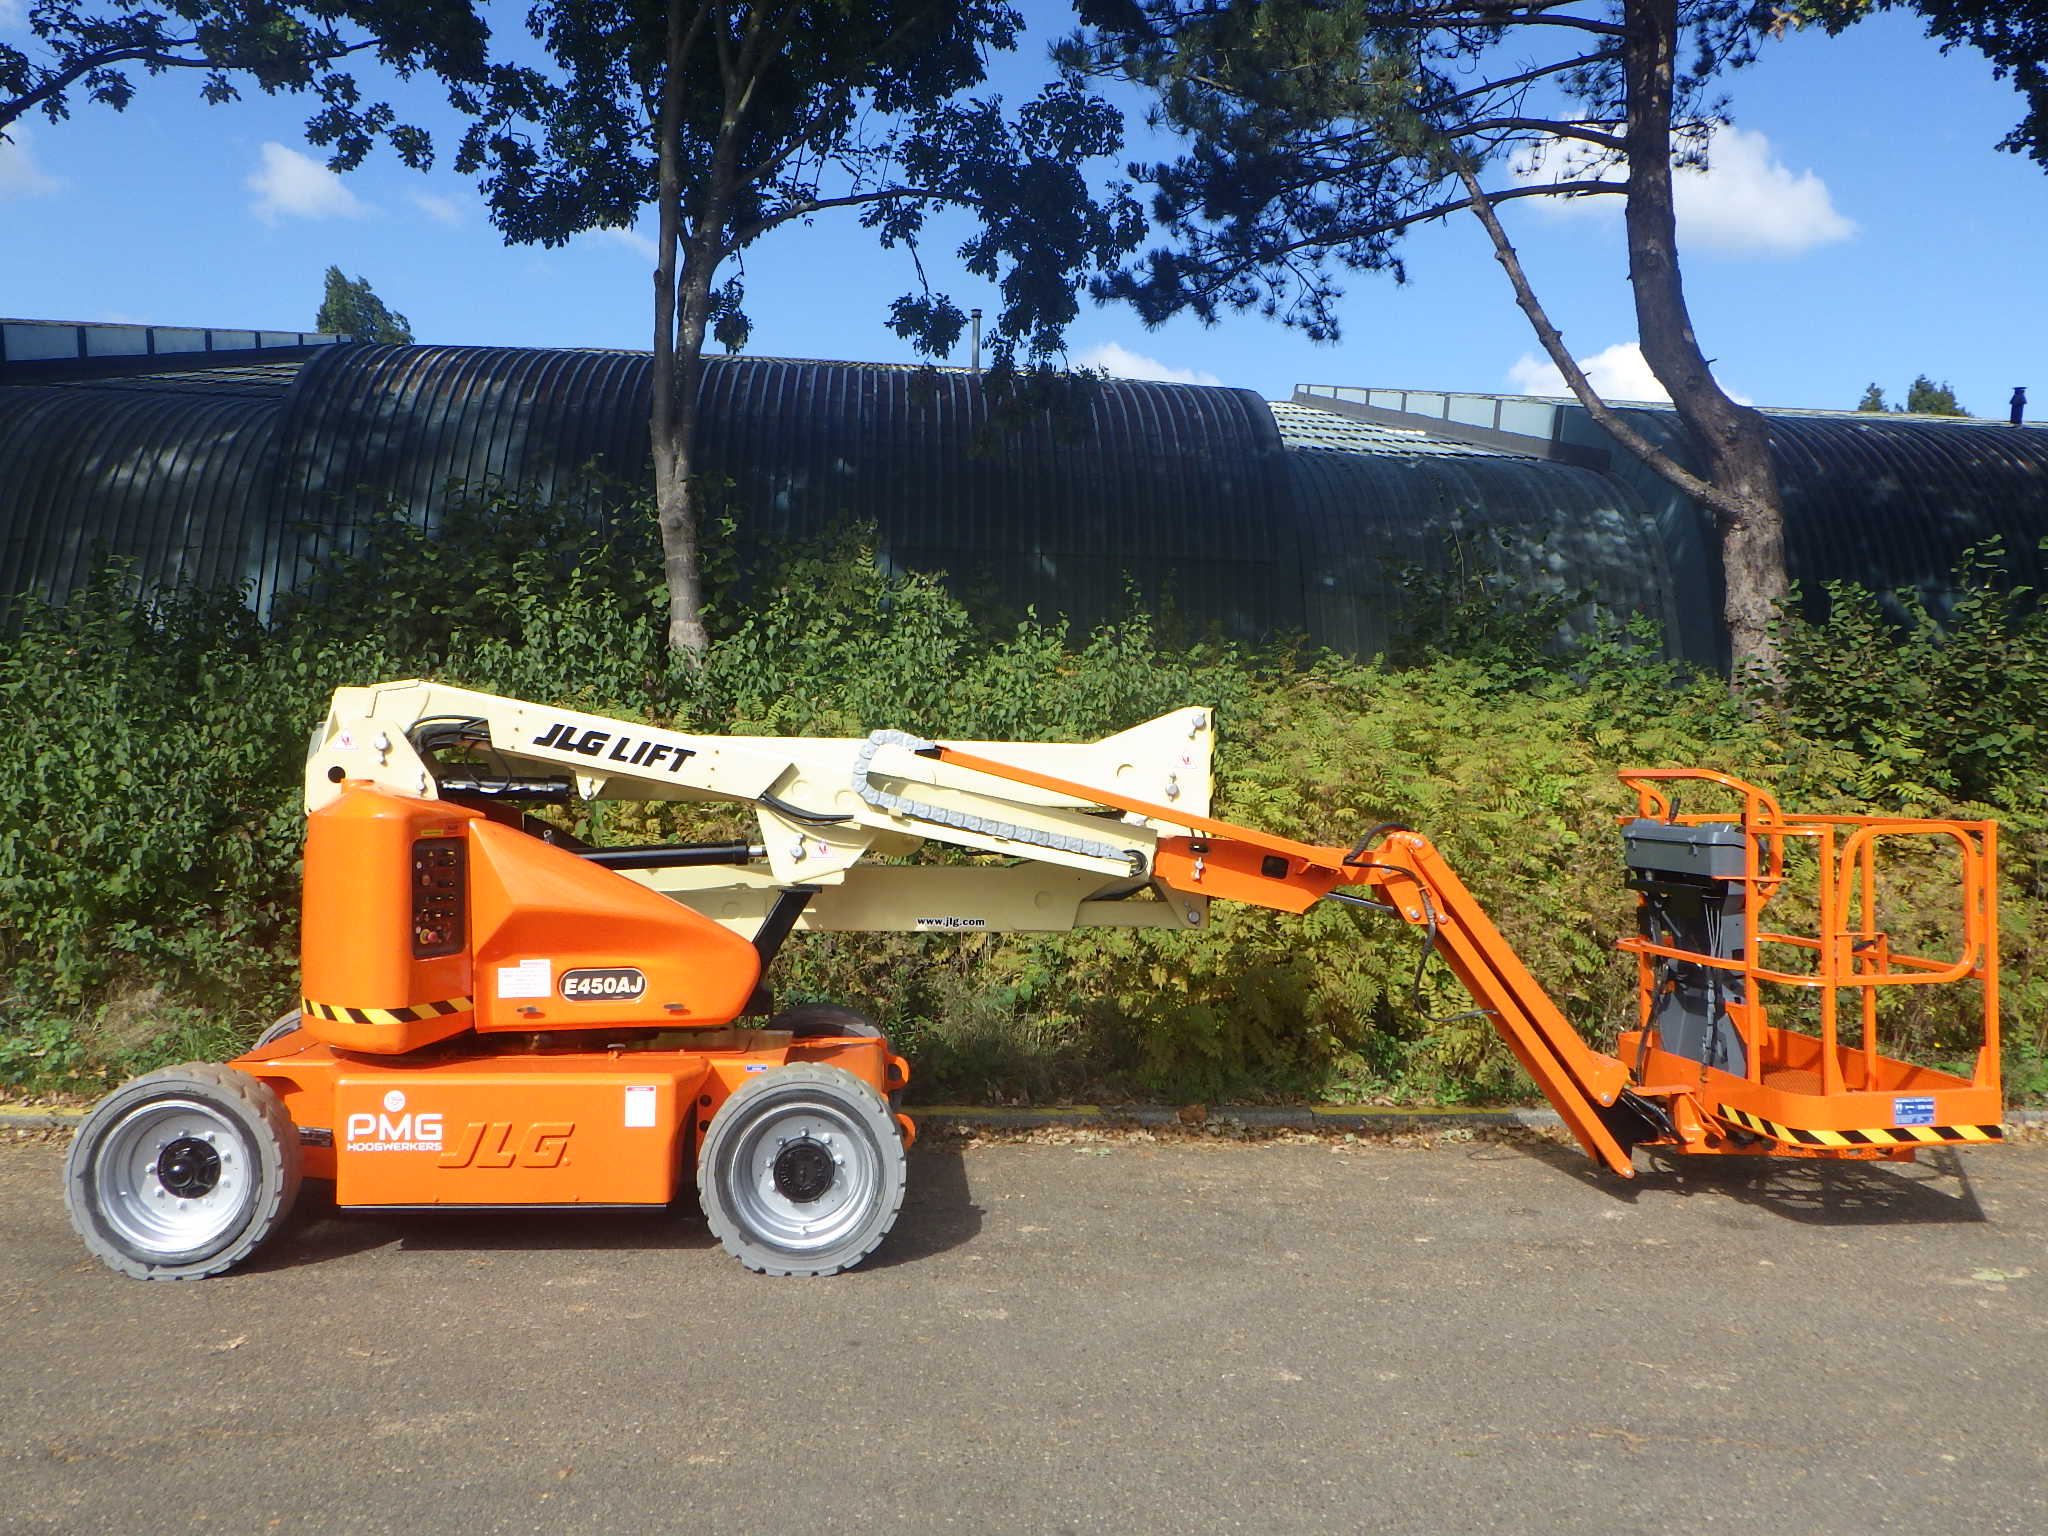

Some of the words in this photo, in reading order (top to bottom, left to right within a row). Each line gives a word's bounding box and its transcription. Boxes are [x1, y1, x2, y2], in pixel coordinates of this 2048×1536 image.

[533, 723, 611, 756] JLG
[608, 737, 697, 772] LIFT
[917, 916, 985, 927] www.jlg.com
[564, 976, 643, 995] E450AJ
[347, 1113, 443, 1141] PMG
[347, 1142, 443, 1152] HOOGWERKERS
[437, 1121, 575, 1168] JLG
